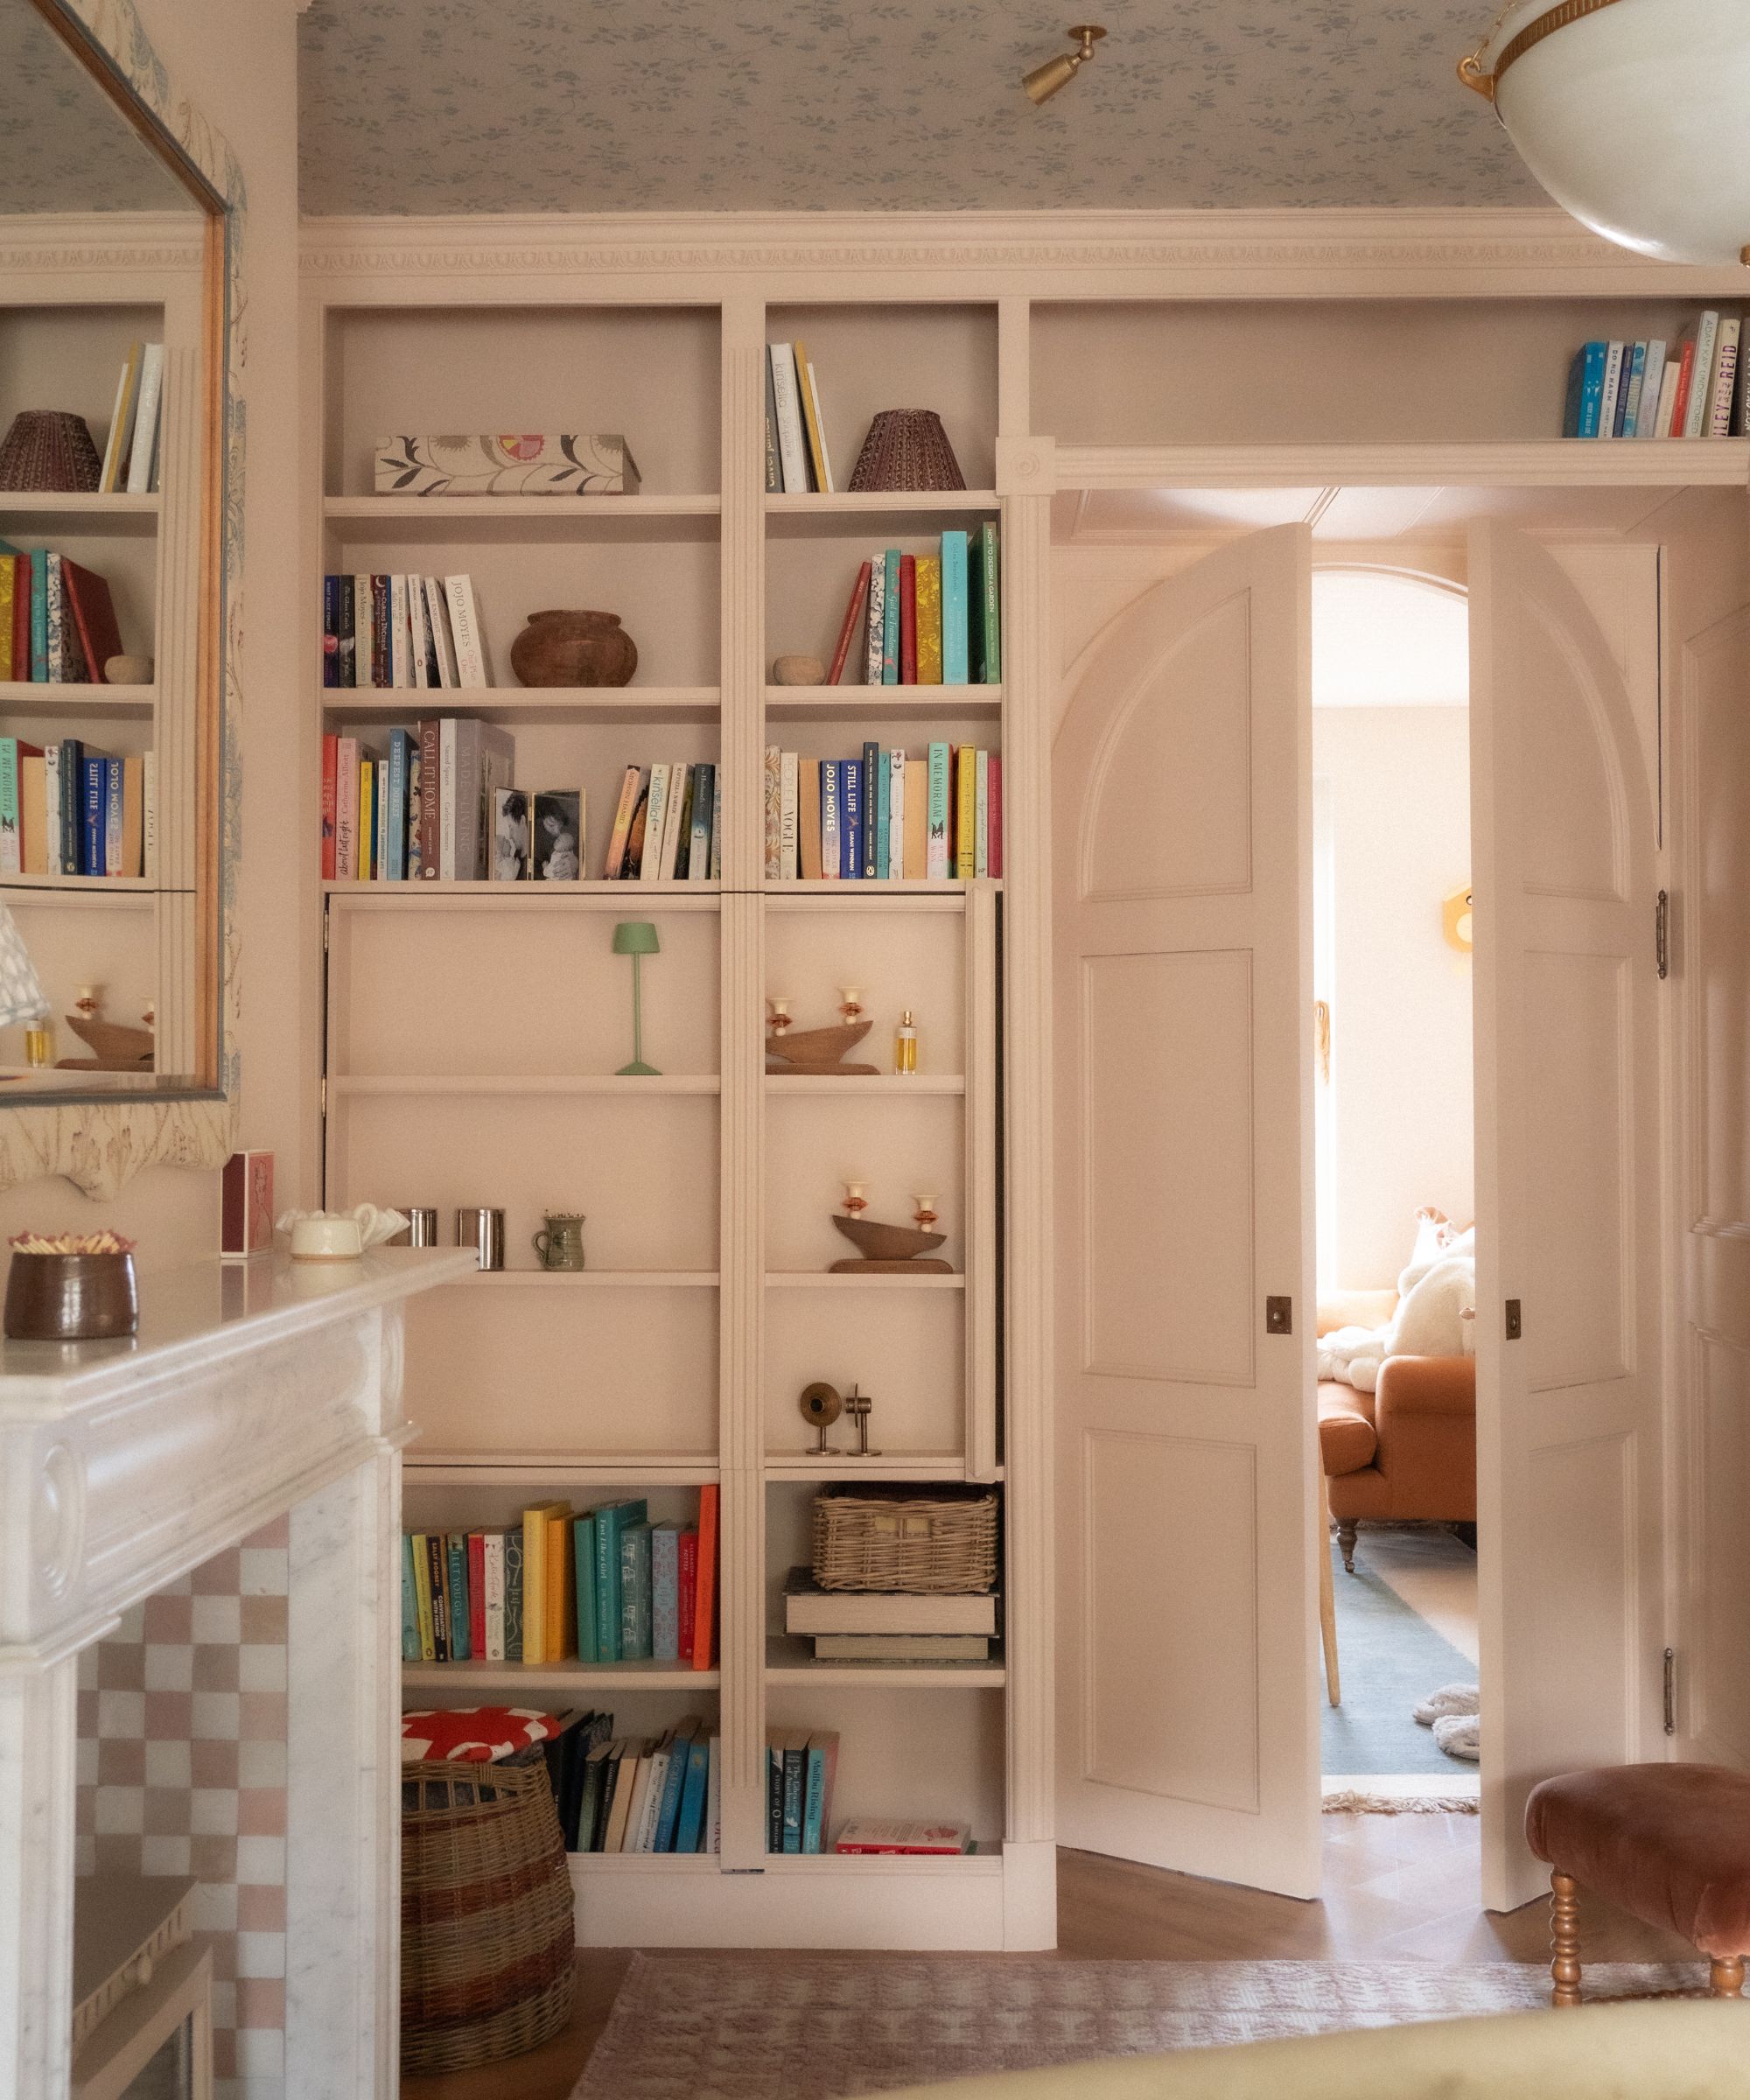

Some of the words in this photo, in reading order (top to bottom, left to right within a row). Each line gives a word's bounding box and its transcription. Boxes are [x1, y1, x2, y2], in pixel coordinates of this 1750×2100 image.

[1702, 319, 1713, 346] ADAM
[1612, 349, 1619, 360] DO
[1718, 345, 1737, 380] REID
[774, 362, 788, 409] kinsella
[1690, 369, 1707, 435] UNDOCTORED
[987, 545, 994, 556] TO
[359, 581, 368, 595] Jojo
[451, 581, 465, 607] JOJO
[886, 595, 898, 610] Girl
[359, 596, 368, 620] Moyes
[457, 608, 470, 648] MOYES
[888, 620, 897, 658] Translation
[393, 741, 402, 784] DEEPEST
[424, 731, 436, 765] CALL
[933, 749, 943, 760] IN
[424, 766, 436, 779] IT
[460, 746, 471, 789] MADE
[827, 763, 836, 793] JOJO
[847, 765, 856, 791] STILL
[424, 781, 436, 821] HOME
[649, 776, 663, 819] kinsella
[847, 793, 856, 813] LIFE
[933, 762, 943, 818] MEMORIAM
[619, 800, 630, 824] HAMID
[827, 794, 836, 832] MOYES
[459, 802, 470, 853] LIVING
[781, 811, 794, 853] VOGUE
[452, 1575, 461, 1600] YOU
[454, 1600, 463, 1616] GO
[811, 1759, 822, 1790] Malibu
[772, 1809, 781, 1818] O
[808, 1791, 820, 1821] Rising
